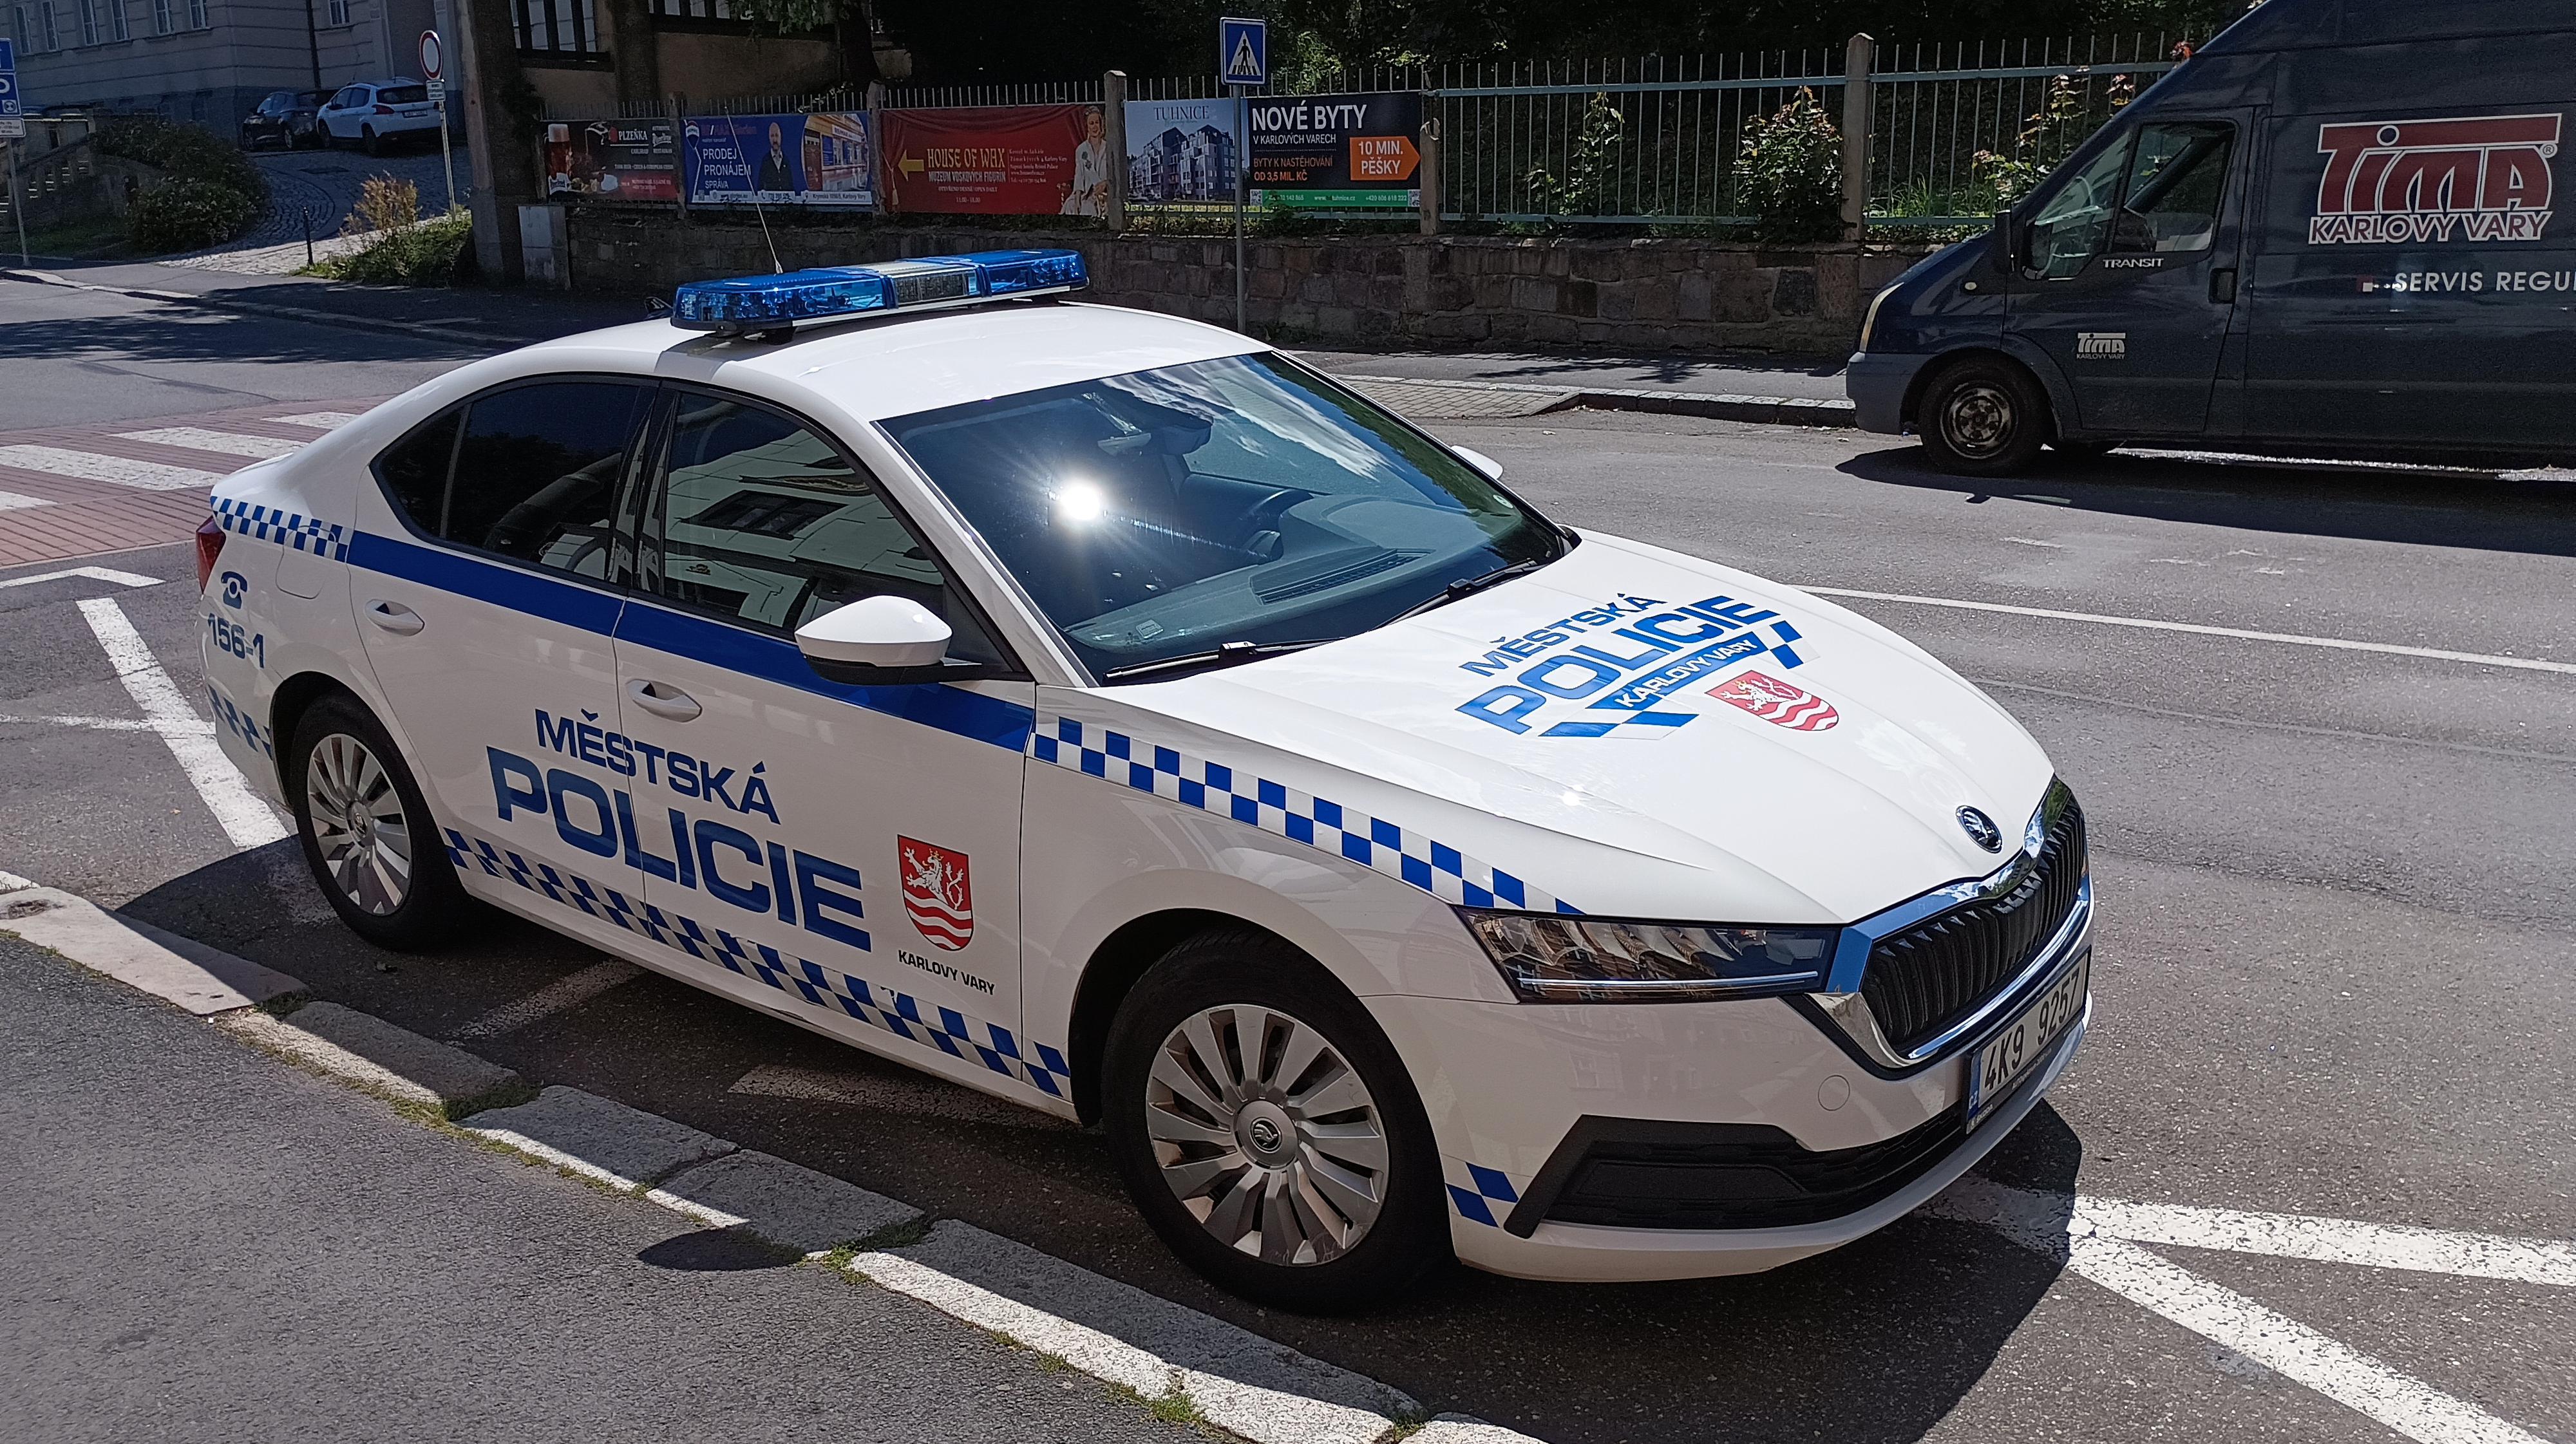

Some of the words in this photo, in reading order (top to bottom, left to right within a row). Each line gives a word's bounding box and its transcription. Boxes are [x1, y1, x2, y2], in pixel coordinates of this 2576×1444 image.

[1153, 106, 1210, 120] TUHNICE
[1252, 99, 1309, 131] NOVÉ
[1314, 104, 1367, 129] BYTY
[618, 129, 649, 141] PLZEŇKA
[1253, 136, 1258, 144] V
[1260, 132, 1305, 144] KARLOVÝCH
[1306, 133, 1336, 144] VARECH
[703, 148, 737, 160] PRODEJ
[1358, 140, 1372, 155] 10
[1376, 140, 1403, 155] MIN.
[927, 148, 962, 168] HOUSE
[964, 148, 978, 168] OF
[980, 148, 1006, 168] WAX
[1253, 157, 1273, 167] BYTY
[1274, 157, 1280, 167] K
[1280, 155, 1333, 167] NASTĚHOVÁNÍ
[1361, 156, 1401, 175] PĚŠKY
[704, 161, 752, 176] PRONÁJEM
[928, 171, 951, 183] MUZEUM
[951, 169, 983, 183] VOSKOVÝCH
[984, 169, 1006, 182] FIGURÍN
[1254, 171, 1267, 181] OD
[1267, 171, 1278, 183] 3,5
[1279, 171, 1295, 181] MIL.
[1296, 169, 1308, 181] KČ
[705, 178, 729, 189] SPRÁVA
[2308, 214, 2460, 245] KARLOVY
[2461, 211, 2553, 242] VARY
[2102, 258, 2164, 268] TRANSIT
[2394, 271, 2483, 292] SERVIS
[2495, 270, 2576, 292] REGU
[207, 612, 264, 669] 156-1
[1459, 592, 1668, 677] MĚSTSKÁ
[1454, 595, 1781, 735] POLICIE
[1614, 657, 1712, 708] KARLOVY
[1703, 639, 1757, 661] VARY
[535, 708, 781, 825] MĚSTSKÁ
[486, 745, 872, 953] POLICIE
[898, 950, 958, 981] KARLOVY
[961, 971, 995, 995] VARY
[1984, 1024, 2024, 1091] 4K9
[2038, 967, 2080, 1046] 9257
